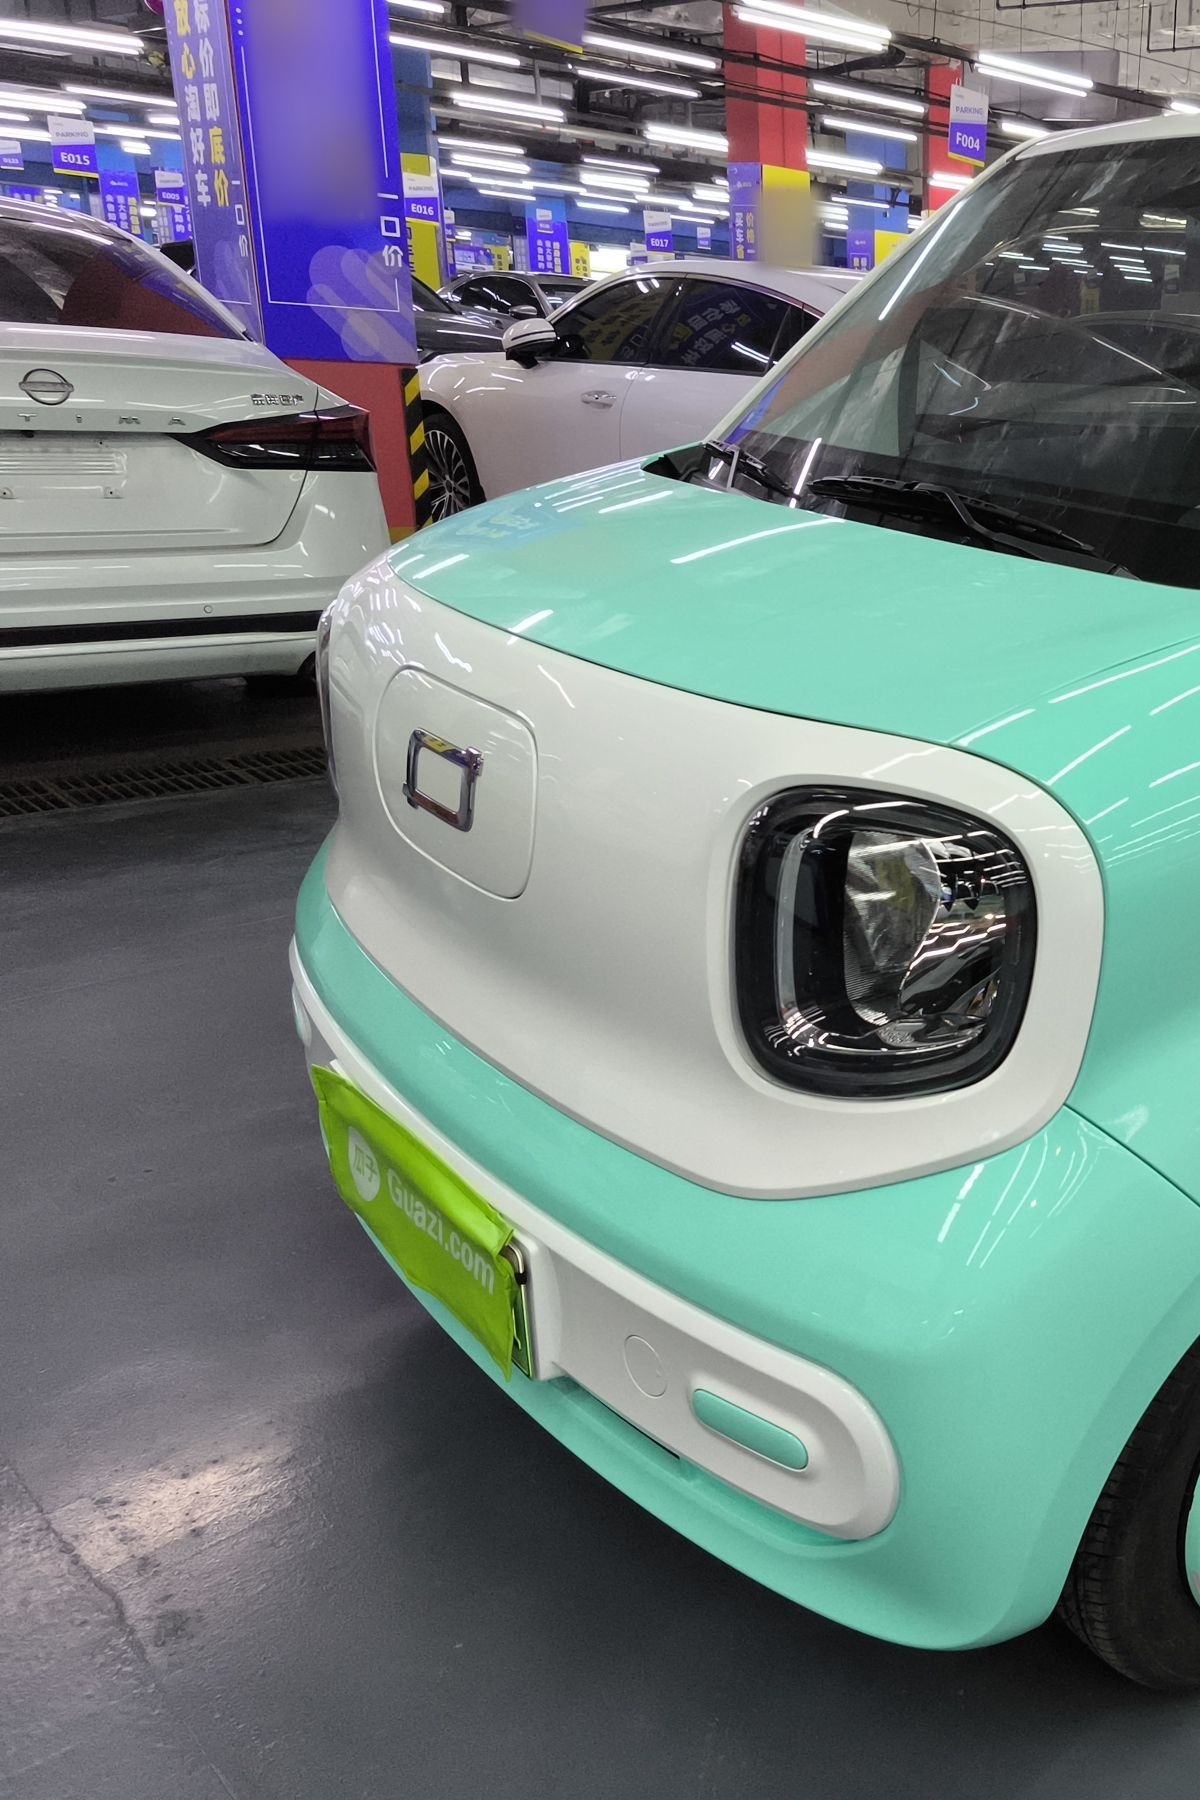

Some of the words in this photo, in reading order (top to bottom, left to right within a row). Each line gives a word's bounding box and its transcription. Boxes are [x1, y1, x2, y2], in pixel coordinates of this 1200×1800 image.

[956, 131, 981, 152] F004
[60, 152, 91, 166] E015
[411, 203, 435, 216] E016
[377, 192, 404, 268] 一口价
[650, 237, 669, 248] E017
[387, 1168, 495, 1296] Guazi.com
